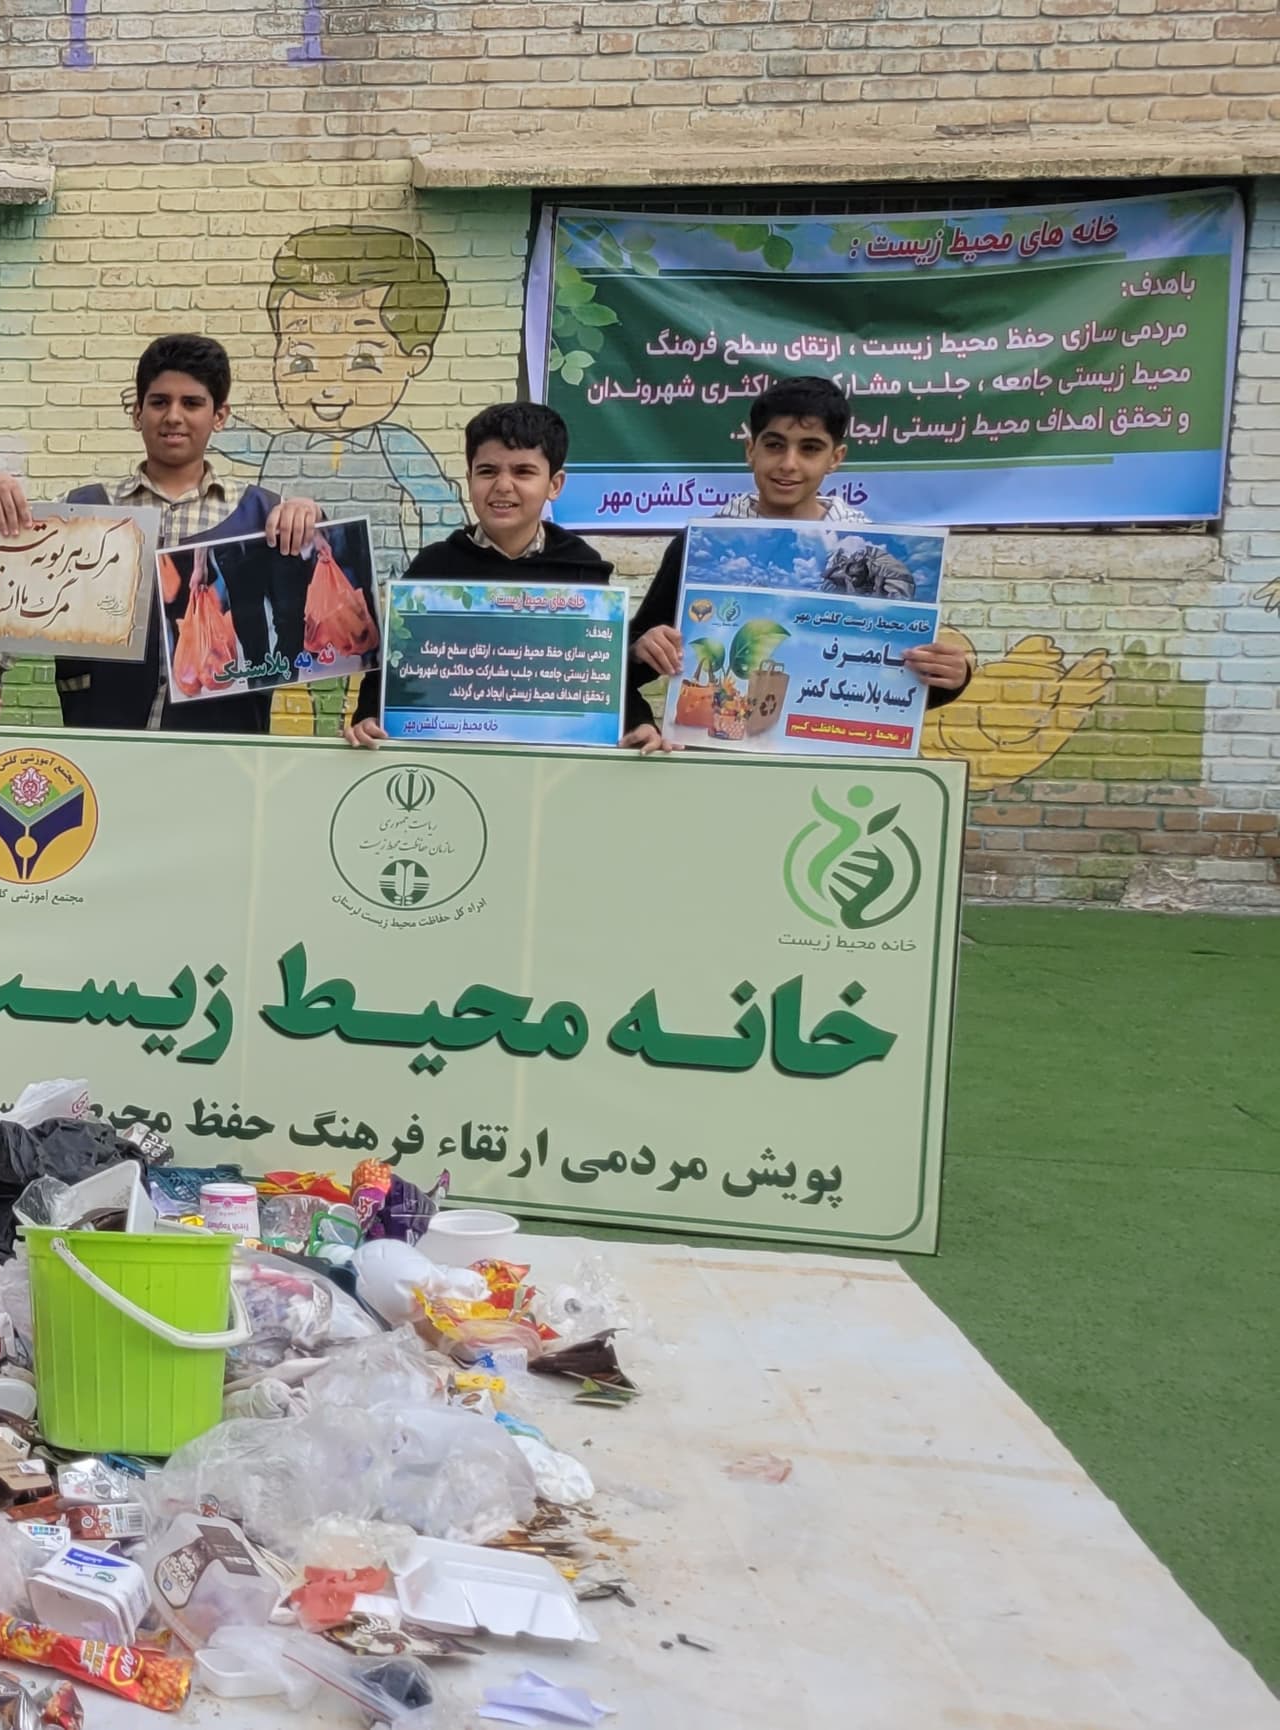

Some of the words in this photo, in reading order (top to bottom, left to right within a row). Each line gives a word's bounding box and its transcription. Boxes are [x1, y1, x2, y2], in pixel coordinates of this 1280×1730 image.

[1020, 220, 1063, 258] های
[1072, 215, 1118, 243] خانه
[867, 231, 942, 266] زیست
[948, 228, 1012, 263] محیط
[646, 328, 717, 362] فرهنگ
[939, 332, 997, 358] محیط
[1006, 327, 1054, 350] حفظ
[1062, 320, 1117, 351] سازی
[1121, 321, 1187, 347] مردمی
[723, 333, 778, 364] سطح
[784, 334, 841, 362] ارتقای
[863, 336, 933, 360] زیست
[909, 372, 970, 400] جلب
[992, 368, 1052, 392] جامعه
[1058, 366, 1125, 395] زیستی
[1132, 361, 1190, 391] محیط
[588, 374, 694, 404] شهروندان
[893, 416, 966, 443] زیستی
[972, 415, 1029, 442] محیط
[1037, 407, 1103, 432] اهداف
[1109, 406, 1171, 436] تحقق
[1178, 412, 1189, 432] و
[597, 494, 638, 516] مهر
[636, 478, 695, 514] گلشن
[75, 517, 132, 579] مرگ
[20, 578, 78, 628] مرگ
[22, 585, 28, 604] ما
[793, 612, 811, 626] مهر
[814, 612, 841, 627] گلشن
[843, 614, 874, 631] زیست
[876, 614, 906, 632] محیط
[907, 616, 931, 633] خانه
[319, 643, 335, 664] نه
[421, 641, 446, 656] فرهنگ
[448, 644, 467, 660] سطح
[469, 644, 491, 659] ارتقای
[498, 648, 522, 659] زیست
[524, 646, 544, 658] محیط
[547, 646, 562, 657] حفظ
[564, 648, 585, 662] سازی
[587, 650, 610, 662] مردمی
[823, 637, 883, 667] مصرف
[214, 651, 291, 684] پلاستیک
[294, 652, 312, 673] به
[400, 663, 438, 679] شهروندان
[540, 669, 562, 681] جامعه
[564, 669, 589, 683] زیستی
[591, 670, 611, 682] محیط
[795, 678, 830, 703] کمتر
[829, 681, 882, 712] پلاستیک
[883, 687, 917, 712] کیسه
[790, 721, 809, 734] کنیم
[811, 721, 846, 736] محافظت
[848, 728, 873, 742] زیست
[874, 731, 899, 744] محیط
[902, 734, 909, 747] از
[11, 889, 49, 903] آموزشی
[51, 892, 84, 905] مجتمع
[362, 912, 388, 928] زیست
[391, 918, 416, 929] محیط
[419, 913, 450, 926] حفاظت
[454, 907, 464, 920] کل
[778, 934, 830, 951] زیست
[836, 936, 876, 952] محیط
[881, 939, 917, 952] خانه
[258, 942, 589, 1074] محیط
[609, 973, 898, 1077] خانه
[184, 1097, 274, 1141] حفظ
[289, 1109, 424, 1167] فرهنگ
[437, 1121, 548, 1178] ارتقاء
[560, 1144, 707, 1191] مردمی
[722, 1146, 843, 1208] پویش
